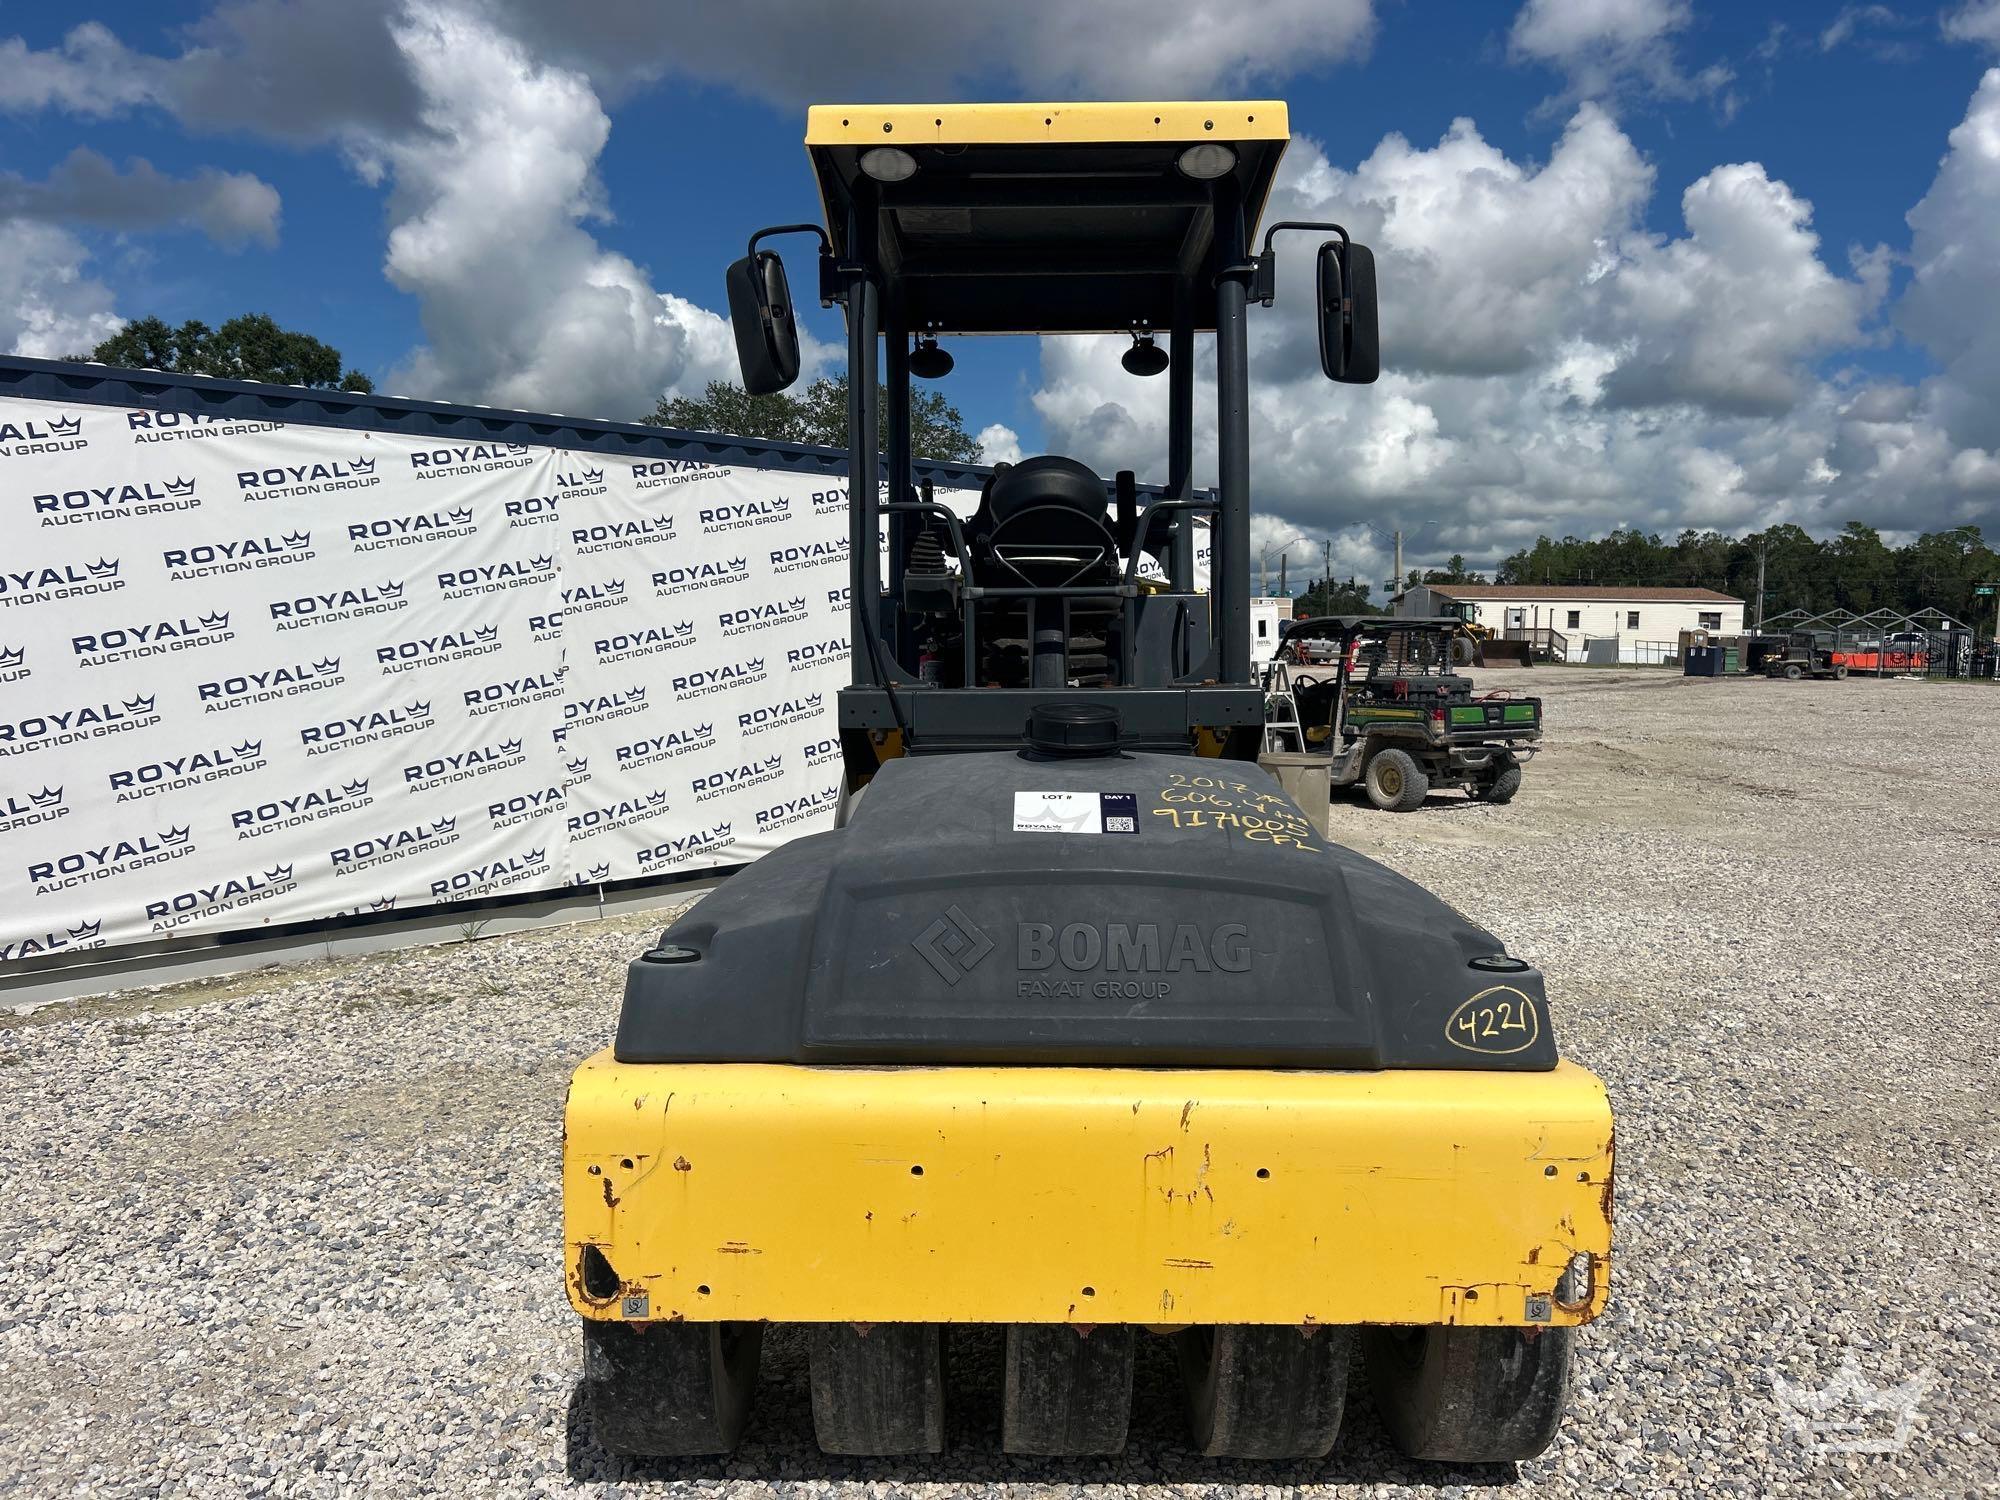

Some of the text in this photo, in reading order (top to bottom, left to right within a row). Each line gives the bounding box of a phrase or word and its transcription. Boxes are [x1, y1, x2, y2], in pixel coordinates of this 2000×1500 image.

[15, 440, 88, 455] GROUP
[135, 422, 285, 444] AUCTION GROUP
[410, 443, 506, 468] ROYAL
[416, 458, 533, 480] AUCTION GROUP
[237, 462, 350, 489] ROYAL
[244, 478, 380, 502] AUCTION GROUP
[636, 470, 731, 489] AUCTION GROUP
[33, 483, 165, 513] ROYAL
[562, 486, 607, 499] GROUP
[41, 499, 201, 527] AUCTION GROUP
[348, 513, 449, 540] ROYAL
[700, 502, 772, 524] ROYAL
[704, 513, 792, 534] AUCTION GROUP
[354, 526, 477, 552] AUCTION GROUP
[572, 520, 654, 544] ROYAL
[577, 532, 676, 555] AUCTION GROUP
[163, 538, 283, 568] ROYAL
[171, 552, 315, 581] AUCTION GROUP
[770, 542, 836, 564] ROYAL
[774, 554, 848, 574] AUCTION GROU
[438, 561, 530, 589] ROYAL
[443, 573, 556, 600] AUCTION GROUP
[652, 562, 728, 586] ROYAL
[656, 573, 749, 597] AUCTION GROUP
[55, 580, 125, 599] GROUP
[270, 588, 378, 619] ROYAL
[585, 596, 628, 611] GROUP
[276, 600, 408, 632] AUCTION GROUP
[719, 602, 789, 627] ROYAL
[723, 612, 808, 637] AUCTION GROUP
[72, 619, 200, 654] ROYAL
[80, 632, 234, 668] AUCTION GROUP
[376, 632, 475, 663] ROYAL
[594, 627, 674, 654] ROYAL
[599, 637, 696, 665] AUCTION GROUP
[382, 643, 502, 675] AUCTION GROUP
[791, 656, 834, 672] AUCTION
[198, 665, 314, 700] ROYAL
[464, 674, 554, 706] ROYAL
[672, 664, 747, 691] ROYAL
[677, 673, 767, 702] AUCTION GROUP
[205, 677, 345, 713] AUCTION GROUP
[469, 696, 530, 717] AUCTION
[607, 703, 649, 719] GROUP
[738, 700, 806, 727] ROYAL
[742, 708, 824, 737] AUCTION GROUP
[93, 716, 161, 737] GROUP
[301, 709, 406, 744] ROYAL
[307, 719, 434, 757] AUCTION GROUP
[616, 730, 694, 761] ROYAL
[620, 739, 716, 772] AUCTION GROUP
[109, 750, 233, 790] ROYAL
[404, 747, 500, 782] ROYAL
[410, 756, 526, 794] AUCTION GROUP
[692, 762, 764, 793] ROYAL
[116, 760, 266, 803] AUCTION GROUP
[696, 770, 784, 803] AUCTION GROUP
[0, 807, 69, 832] GROUP
[231, 788, 343, 828] ROYAL
[238, 797, 373, 840] AUCTION GROUP
[493, 806, 553, 830] AUCTION
[568, 799, 647, 832] ROYAL
[756, 794, 822, 824] ROYAL
[570, 806, 669, 843] AUCTION GROUP
[759, 813, 804, 834] AUCTION
[28, 837, 160, 882] ROYAL
[330, 826, 432, 866] ROYAL
[336, 834, 460, 877] AUCTION GROUP
[637, 831, 714, 864] ROYAL
[641, 837, 736, 874] AUCTION GROUP
[36, 845, 195, 896] AUCTION GROUP
[431, 858, 524, 896] ROYAL
[502, 865, 550, 886] GROUP
[146, 876, 265, 920] ROYAL
[152, 882, 297, 933] AUCTION GROUP
[1017, 922, 1252, 973] BOMAG
[1017, 981, 1171, 999] FAYAT GROUP
[1459, 1002, 1527, 1043] 4221
